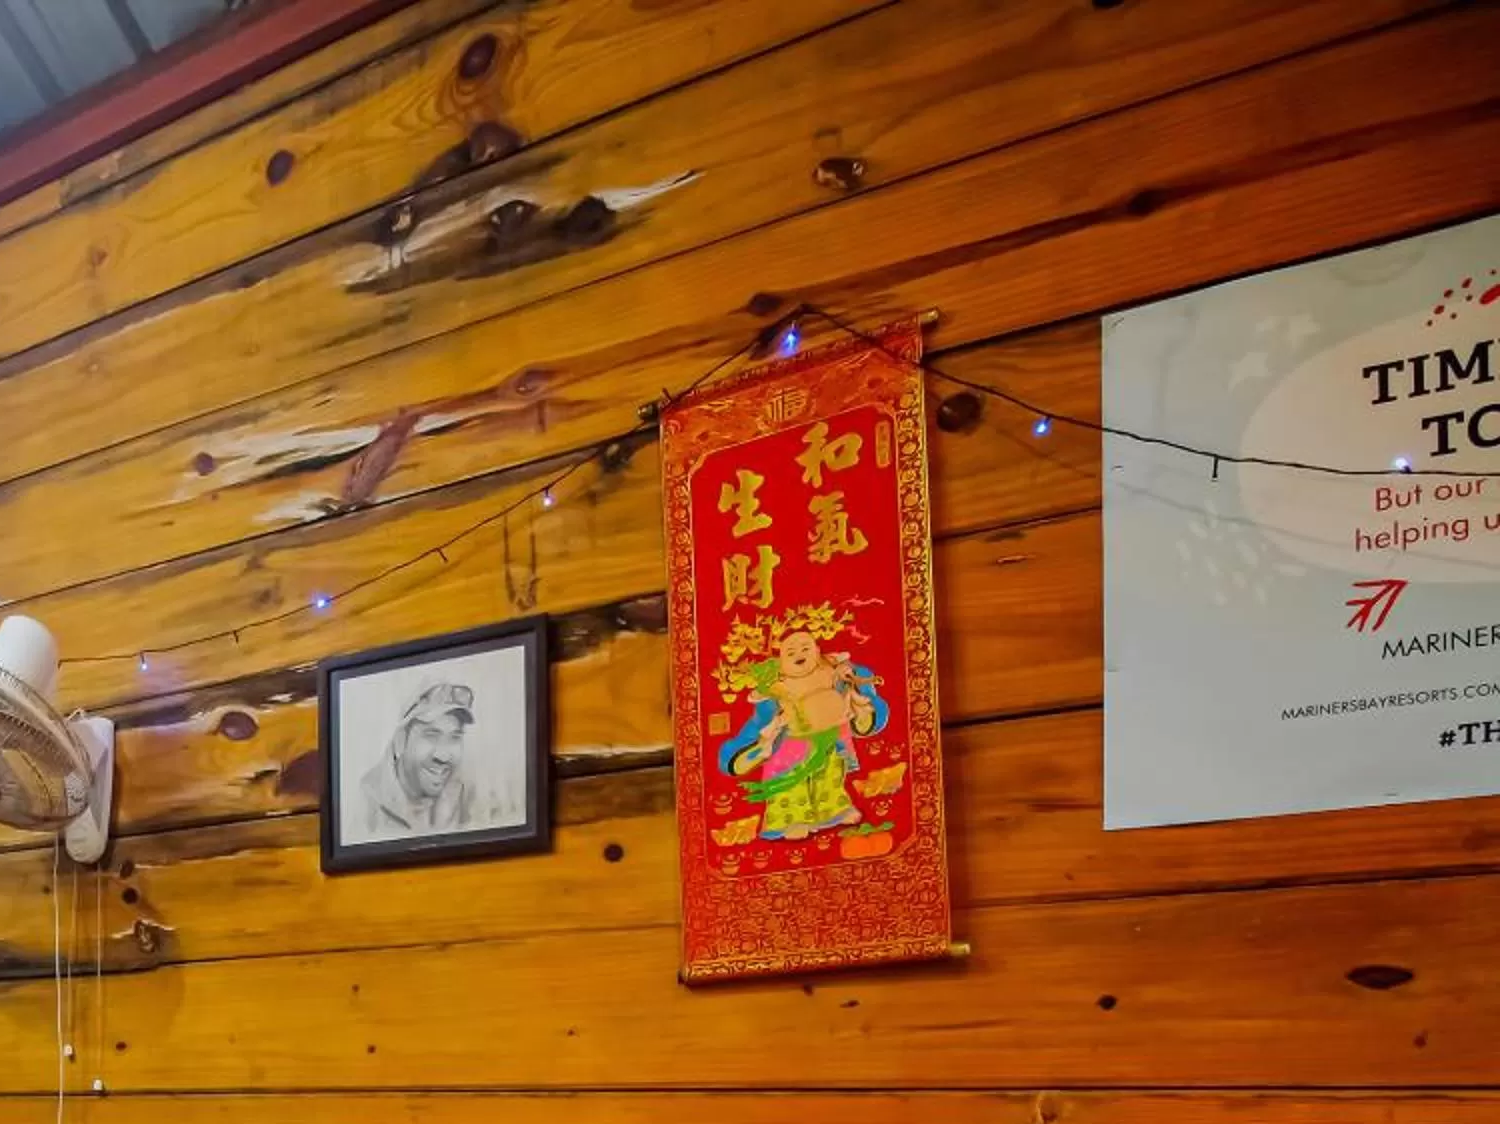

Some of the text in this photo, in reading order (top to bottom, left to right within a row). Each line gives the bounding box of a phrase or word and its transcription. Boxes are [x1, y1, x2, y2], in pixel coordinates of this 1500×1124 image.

[1362, 338, 1500, 405] TIM
[1375, 477, 1488, 512] But our
[1355, 516, 1470, 552] helping
